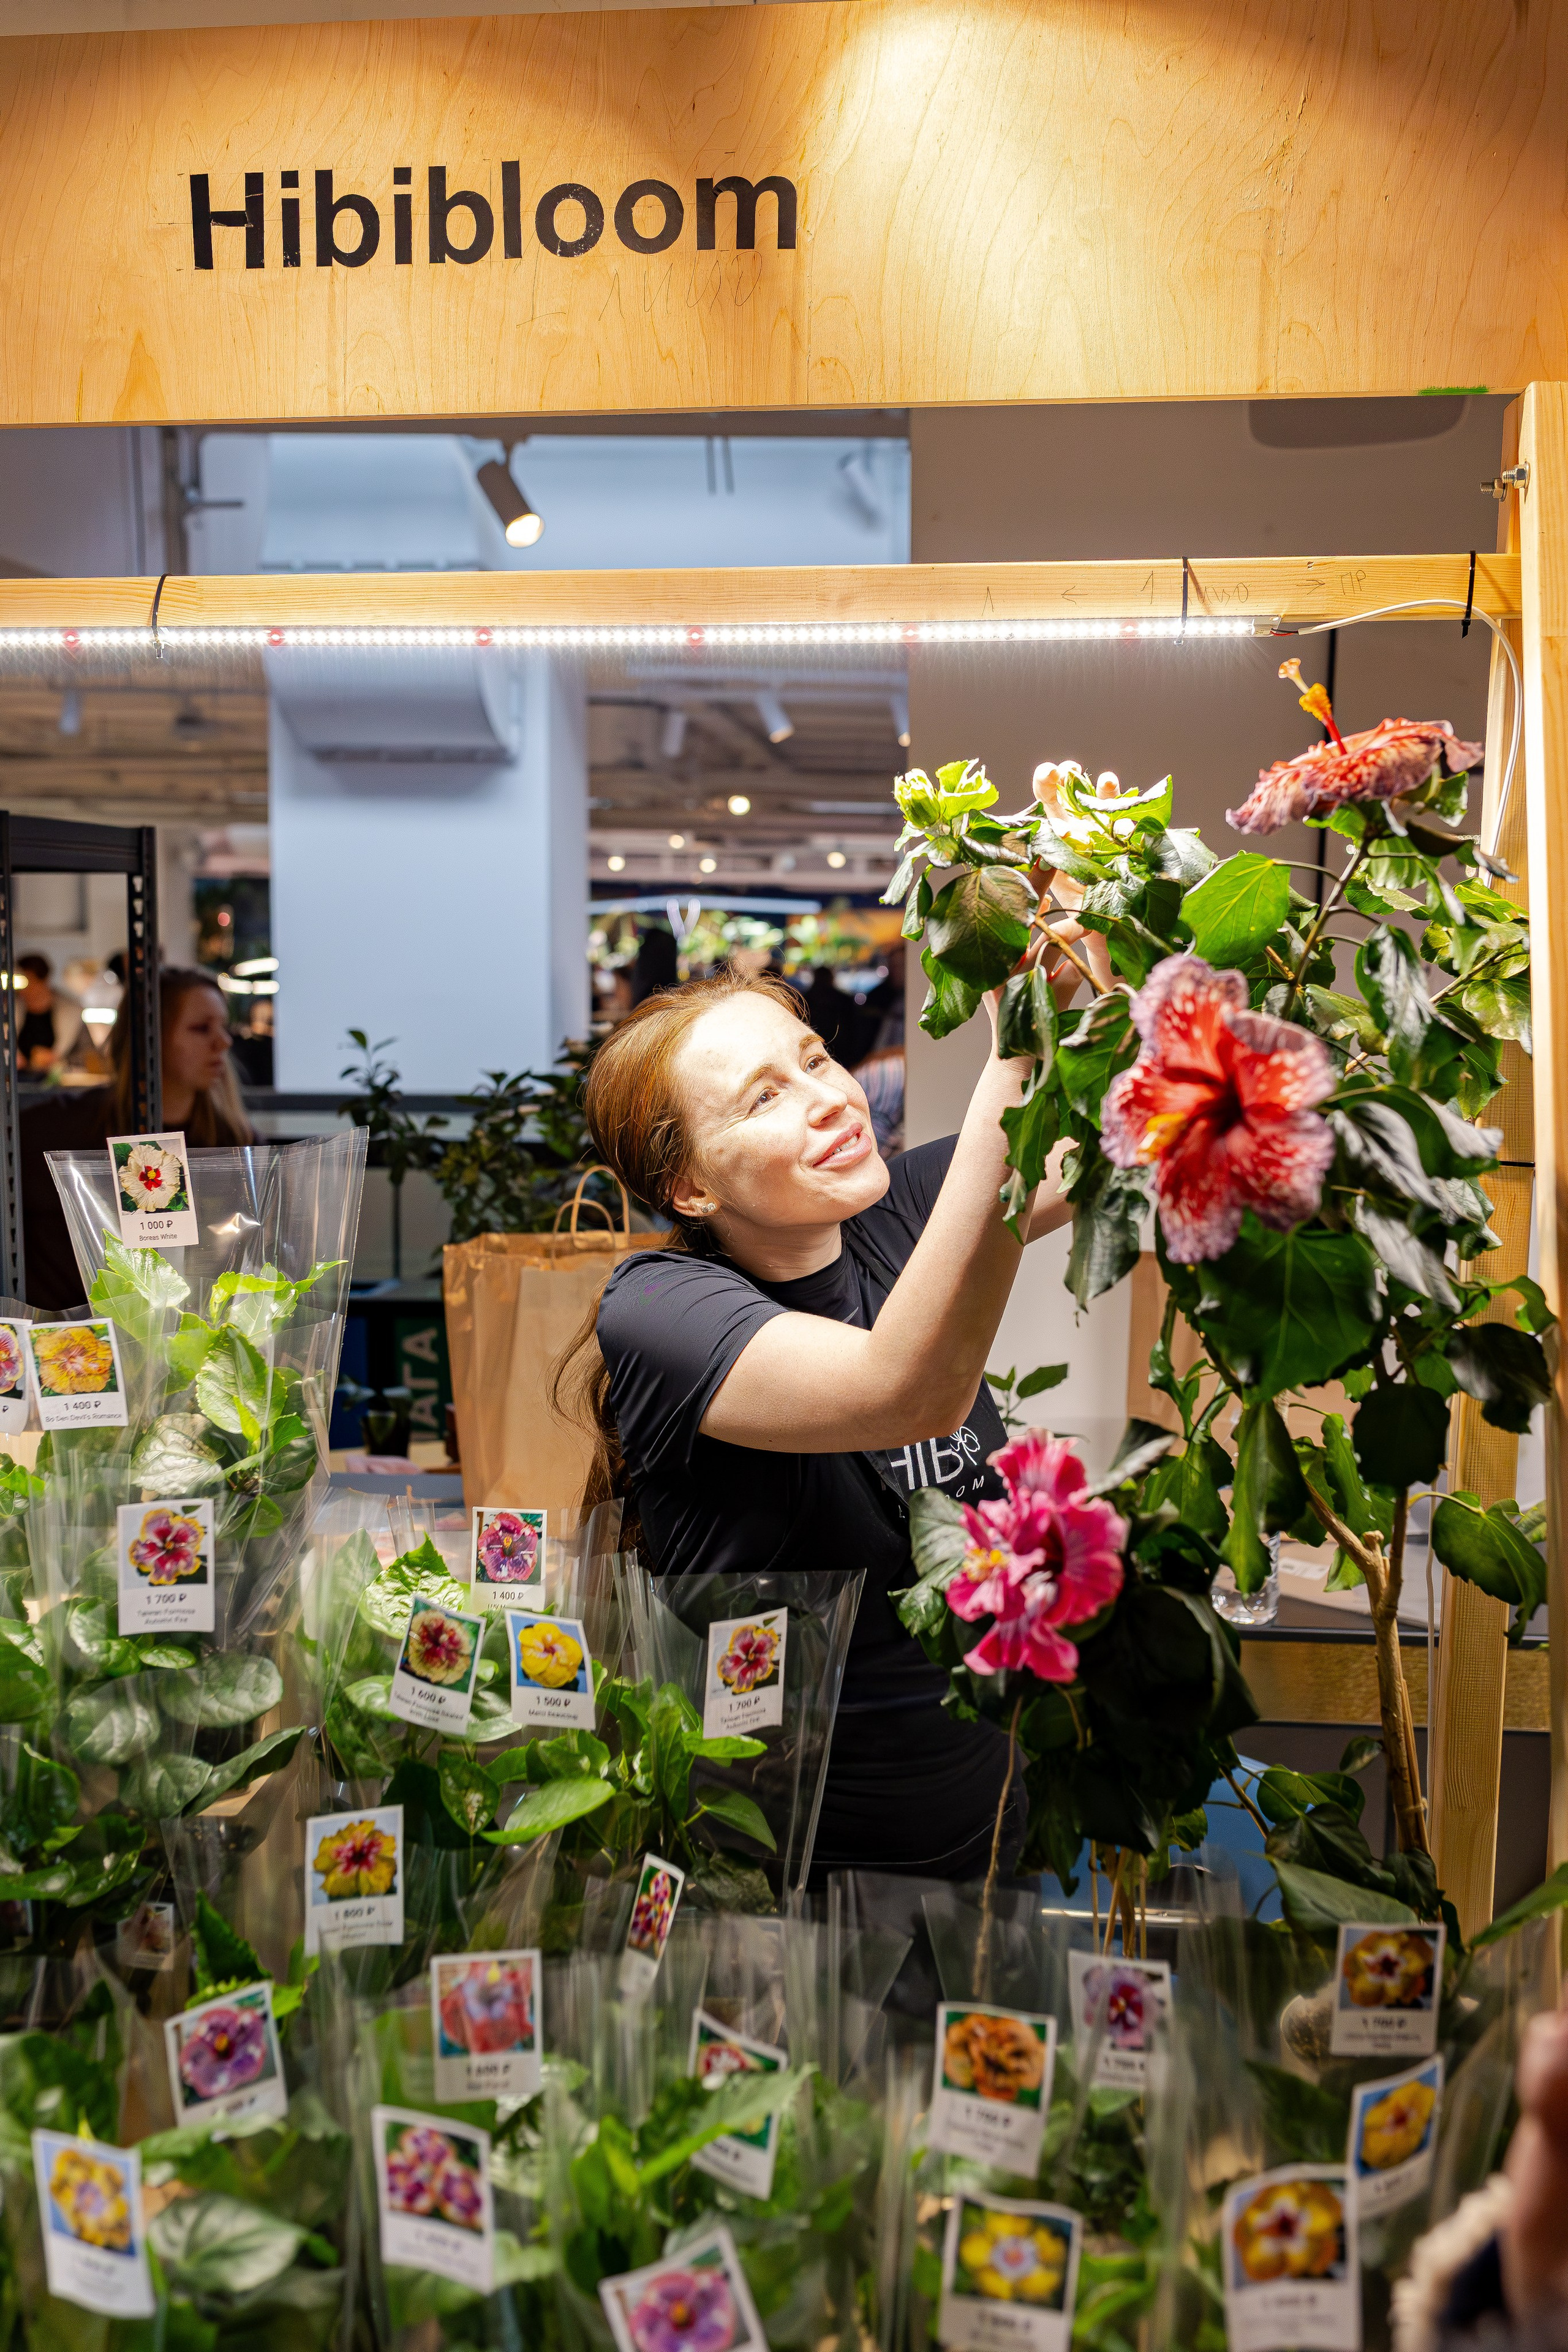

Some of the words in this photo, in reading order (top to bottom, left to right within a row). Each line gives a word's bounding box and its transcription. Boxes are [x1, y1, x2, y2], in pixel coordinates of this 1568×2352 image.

[190, 160, 797, 270] Hibibloom
[148, 1221, 164, 1229] 000
[73, 1401, 91, 1410] 400
[499, 1591, 515, 1600] 400
